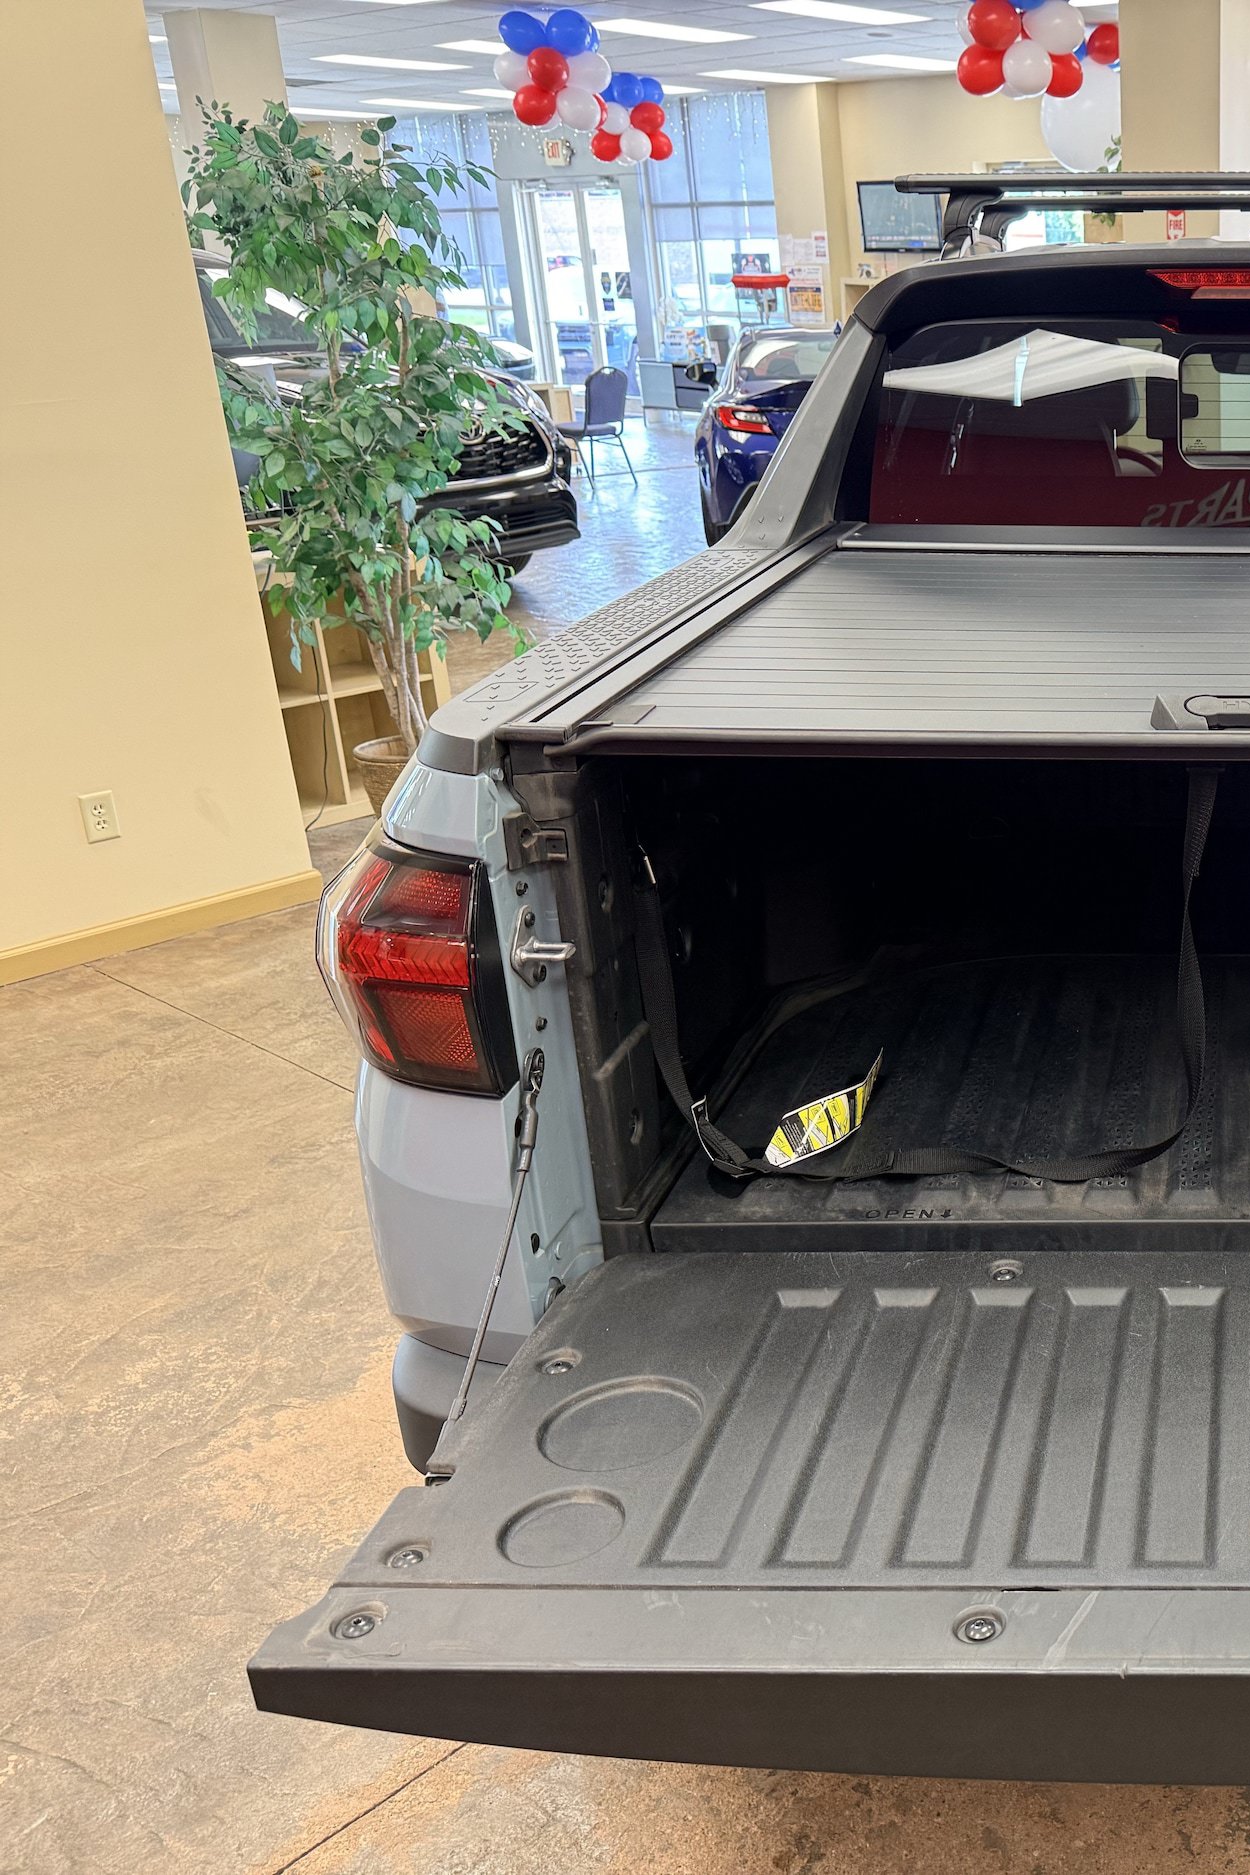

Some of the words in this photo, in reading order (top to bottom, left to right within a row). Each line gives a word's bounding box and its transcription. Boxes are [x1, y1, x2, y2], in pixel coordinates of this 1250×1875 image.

[546, 142, 560, 159] EXIT
[1169, 219, 1183, 231] FIRE
[865, 1209, 934, 1219] OPEN
